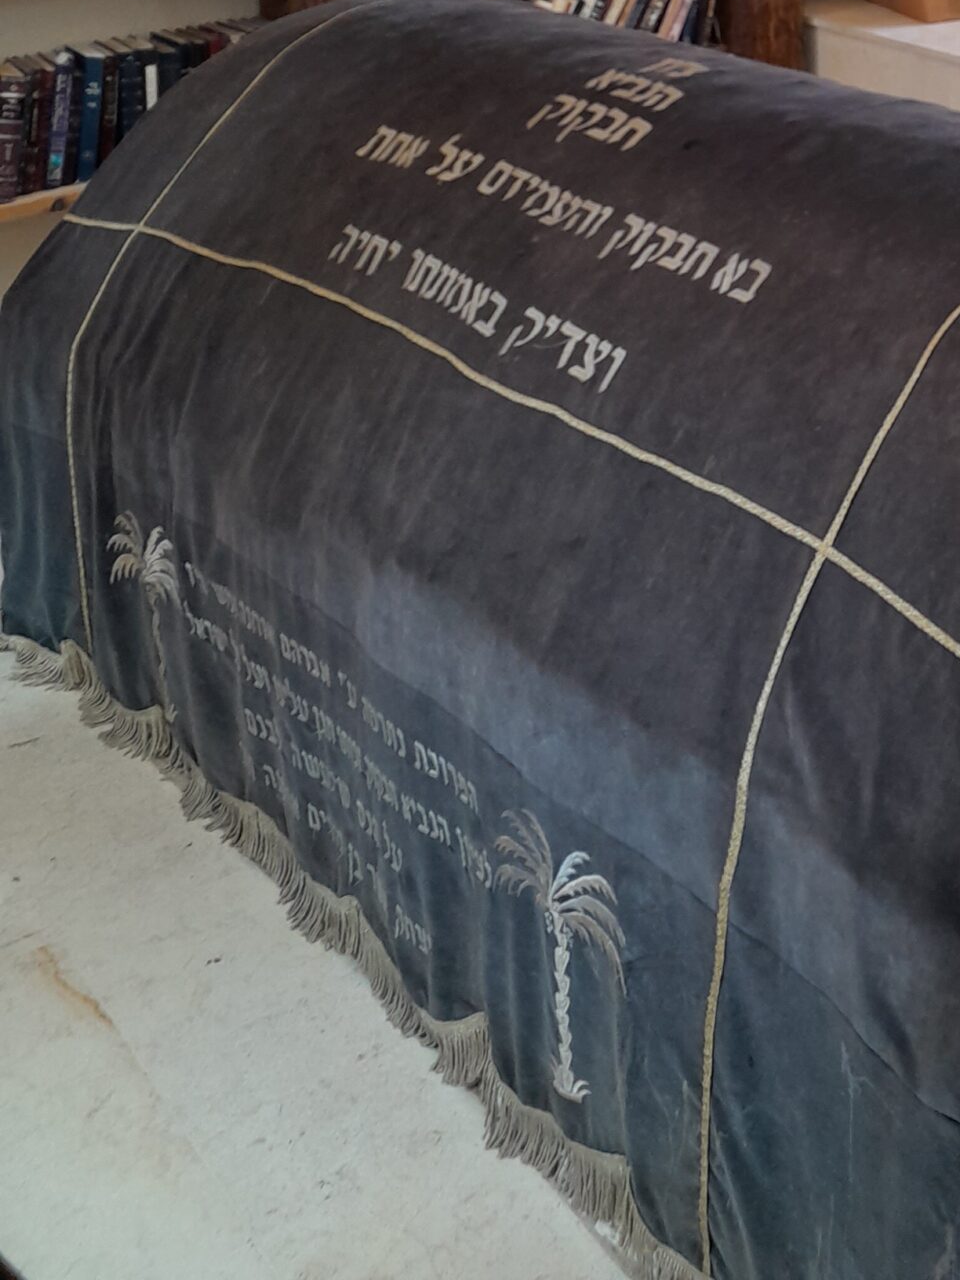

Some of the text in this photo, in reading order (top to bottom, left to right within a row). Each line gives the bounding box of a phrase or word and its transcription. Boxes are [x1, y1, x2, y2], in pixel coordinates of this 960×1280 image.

[525, 93, 654, 152] חבקוק
[584, 68, 685, 112] הנביא
[355, 124, 773, 304] בא חבקוק והעמידם על אחת
[327, 223, 402, 276] יחיה
[499, 305, 628, 393] וצדיק
[414, 739, 480, 815] הפרוכת
